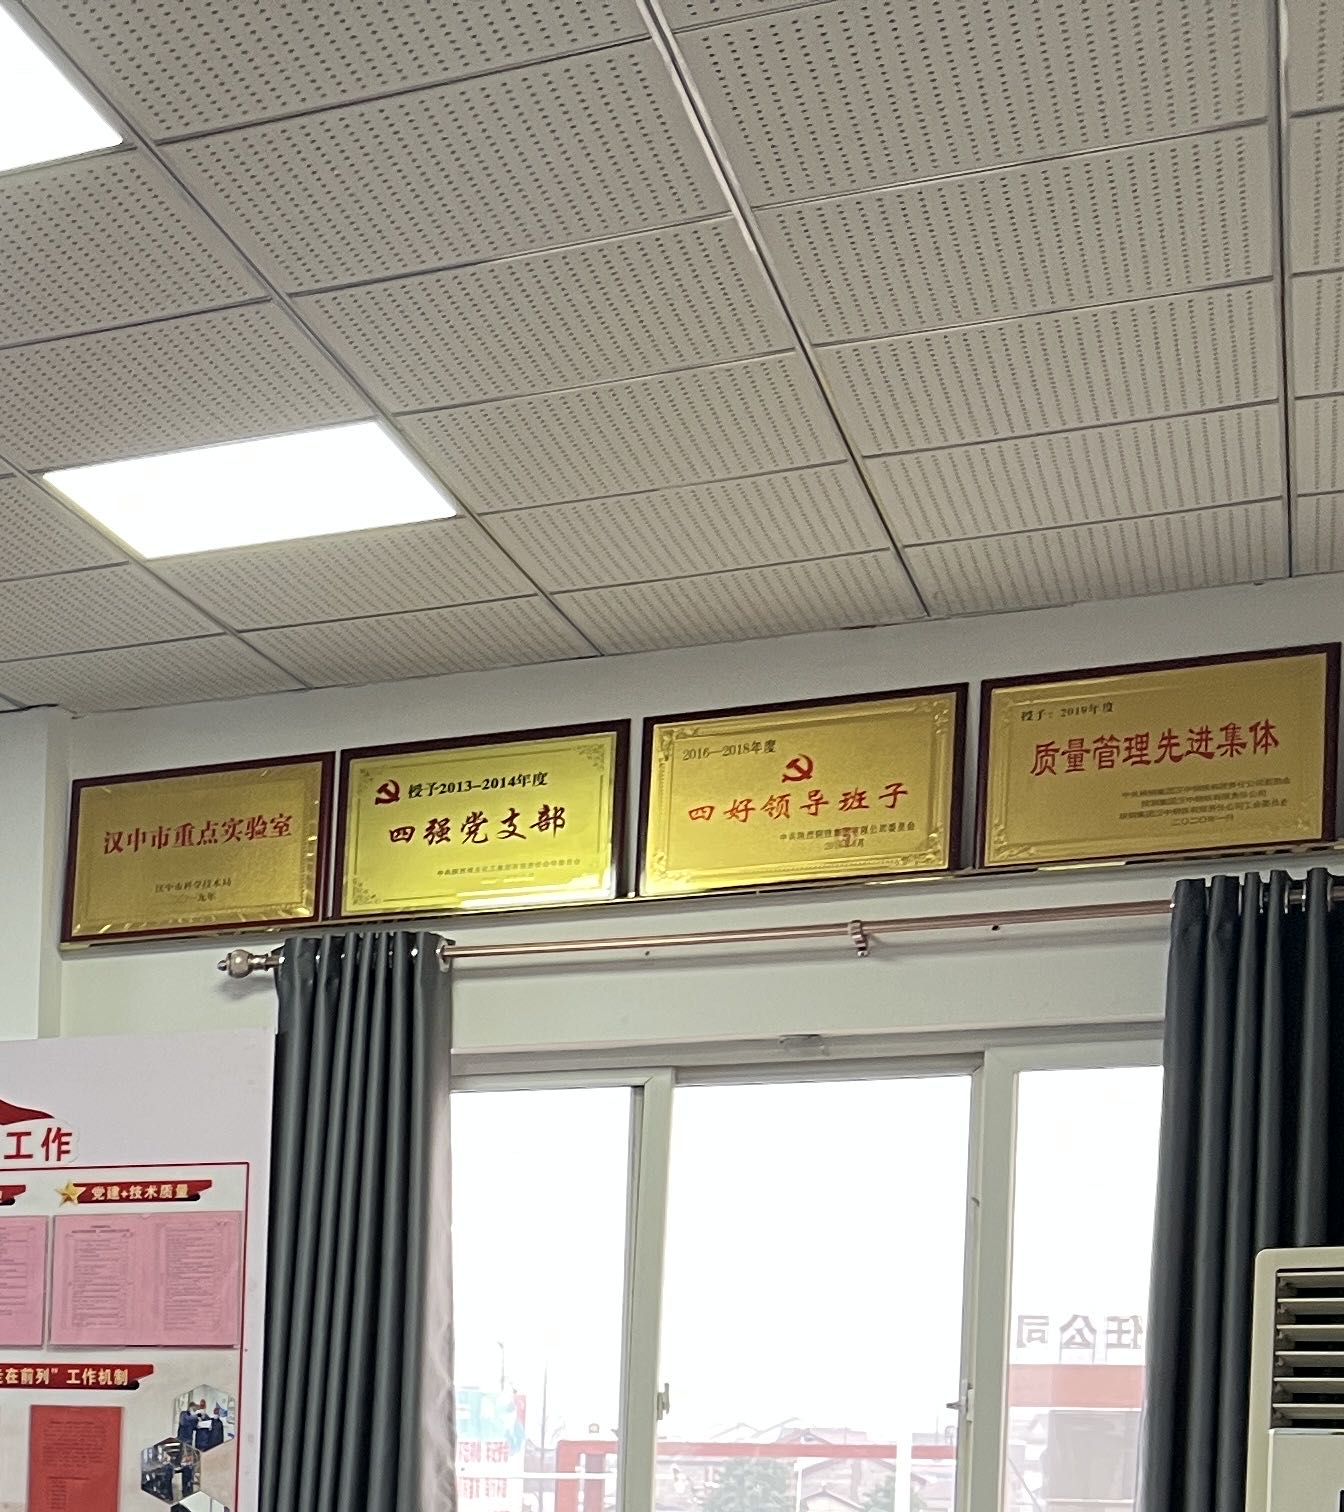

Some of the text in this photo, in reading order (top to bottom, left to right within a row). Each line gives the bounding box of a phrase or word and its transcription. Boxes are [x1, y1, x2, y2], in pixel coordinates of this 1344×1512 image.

[1030, 718, 1280, 777] 质量管理先进集体
[688, 782, 909, 823] 四好领导班子
[103, 812, 293, 855] 汉中市重点实验室
[388, 804, 566, 846] 四强党支部
